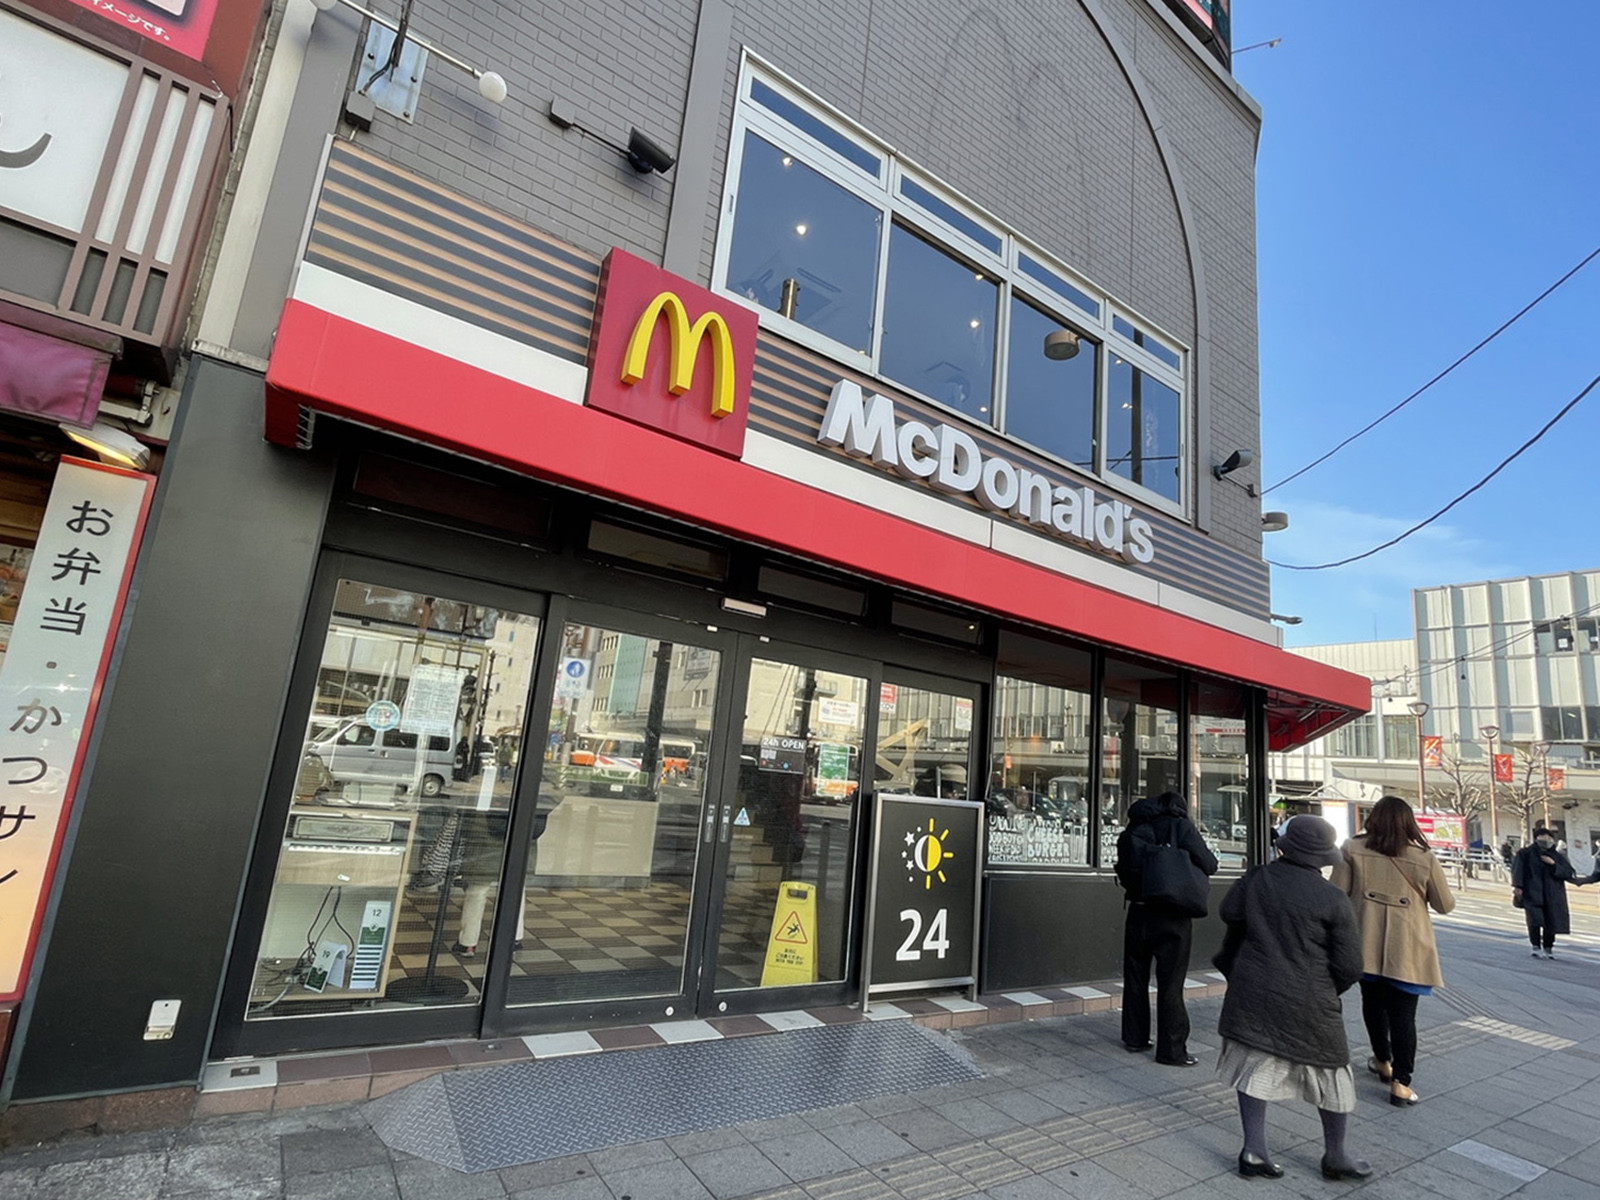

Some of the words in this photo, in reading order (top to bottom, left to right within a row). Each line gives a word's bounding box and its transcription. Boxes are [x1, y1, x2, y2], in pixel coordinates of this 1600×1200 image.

[817, 378, 1154, 565] McDonald's
[781, 739, 805, 750] OPEN
[1027, 843, 1070, 858] BURGER
[896, 908, 950, 961] 24
